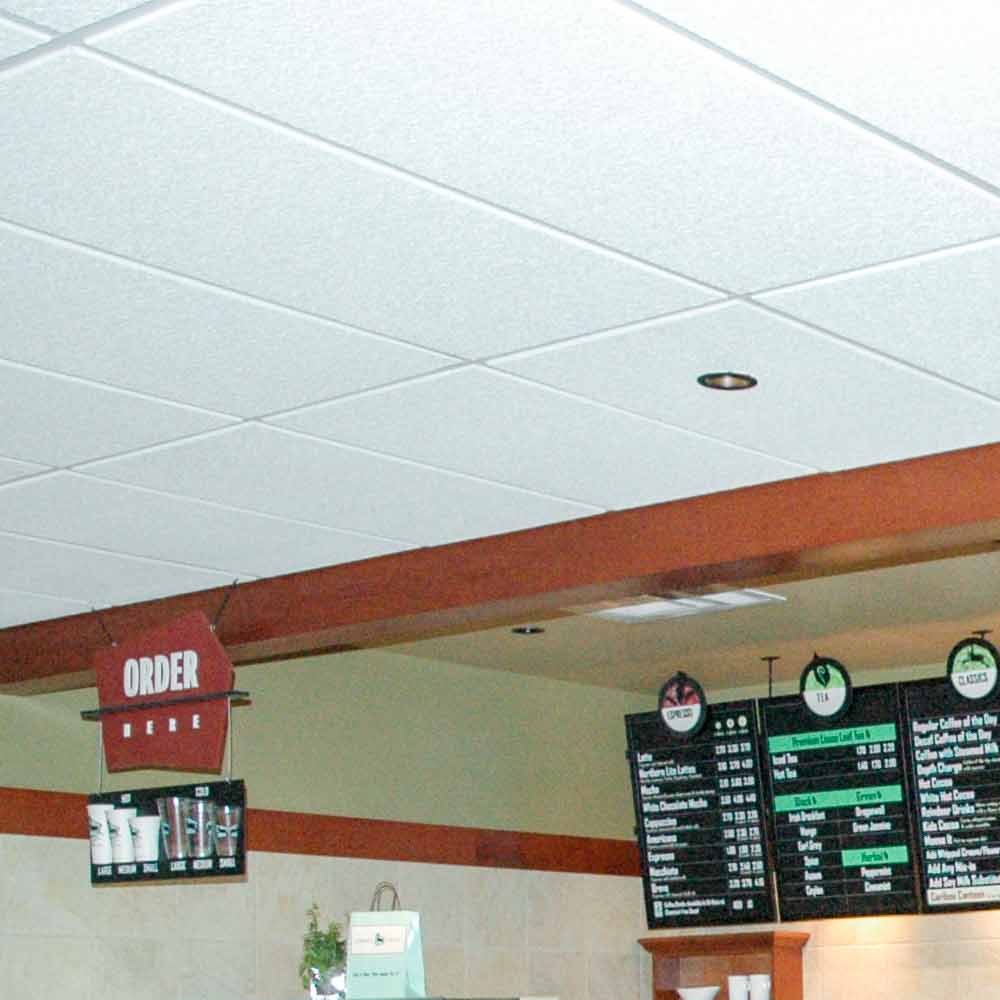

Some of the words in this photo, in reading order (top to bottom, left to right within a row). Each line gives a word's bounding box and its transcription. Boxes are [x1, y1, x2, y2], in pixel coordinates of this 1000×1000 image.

[122, 649, 200, 698] ORDER
[816, 692, 829, 704] TEA
[912, 719, 939, 734] Regular
[939, 716, 962, 730] Coffee
[971, 715, 983, 726] the
[983, 712, 998, 727] Day
[934, 732, 957, 745] Coffee
[966, 730, 978, 741] the
[978, 728, 992, 742] Day
[915, 748, 938, 761] Coffee
